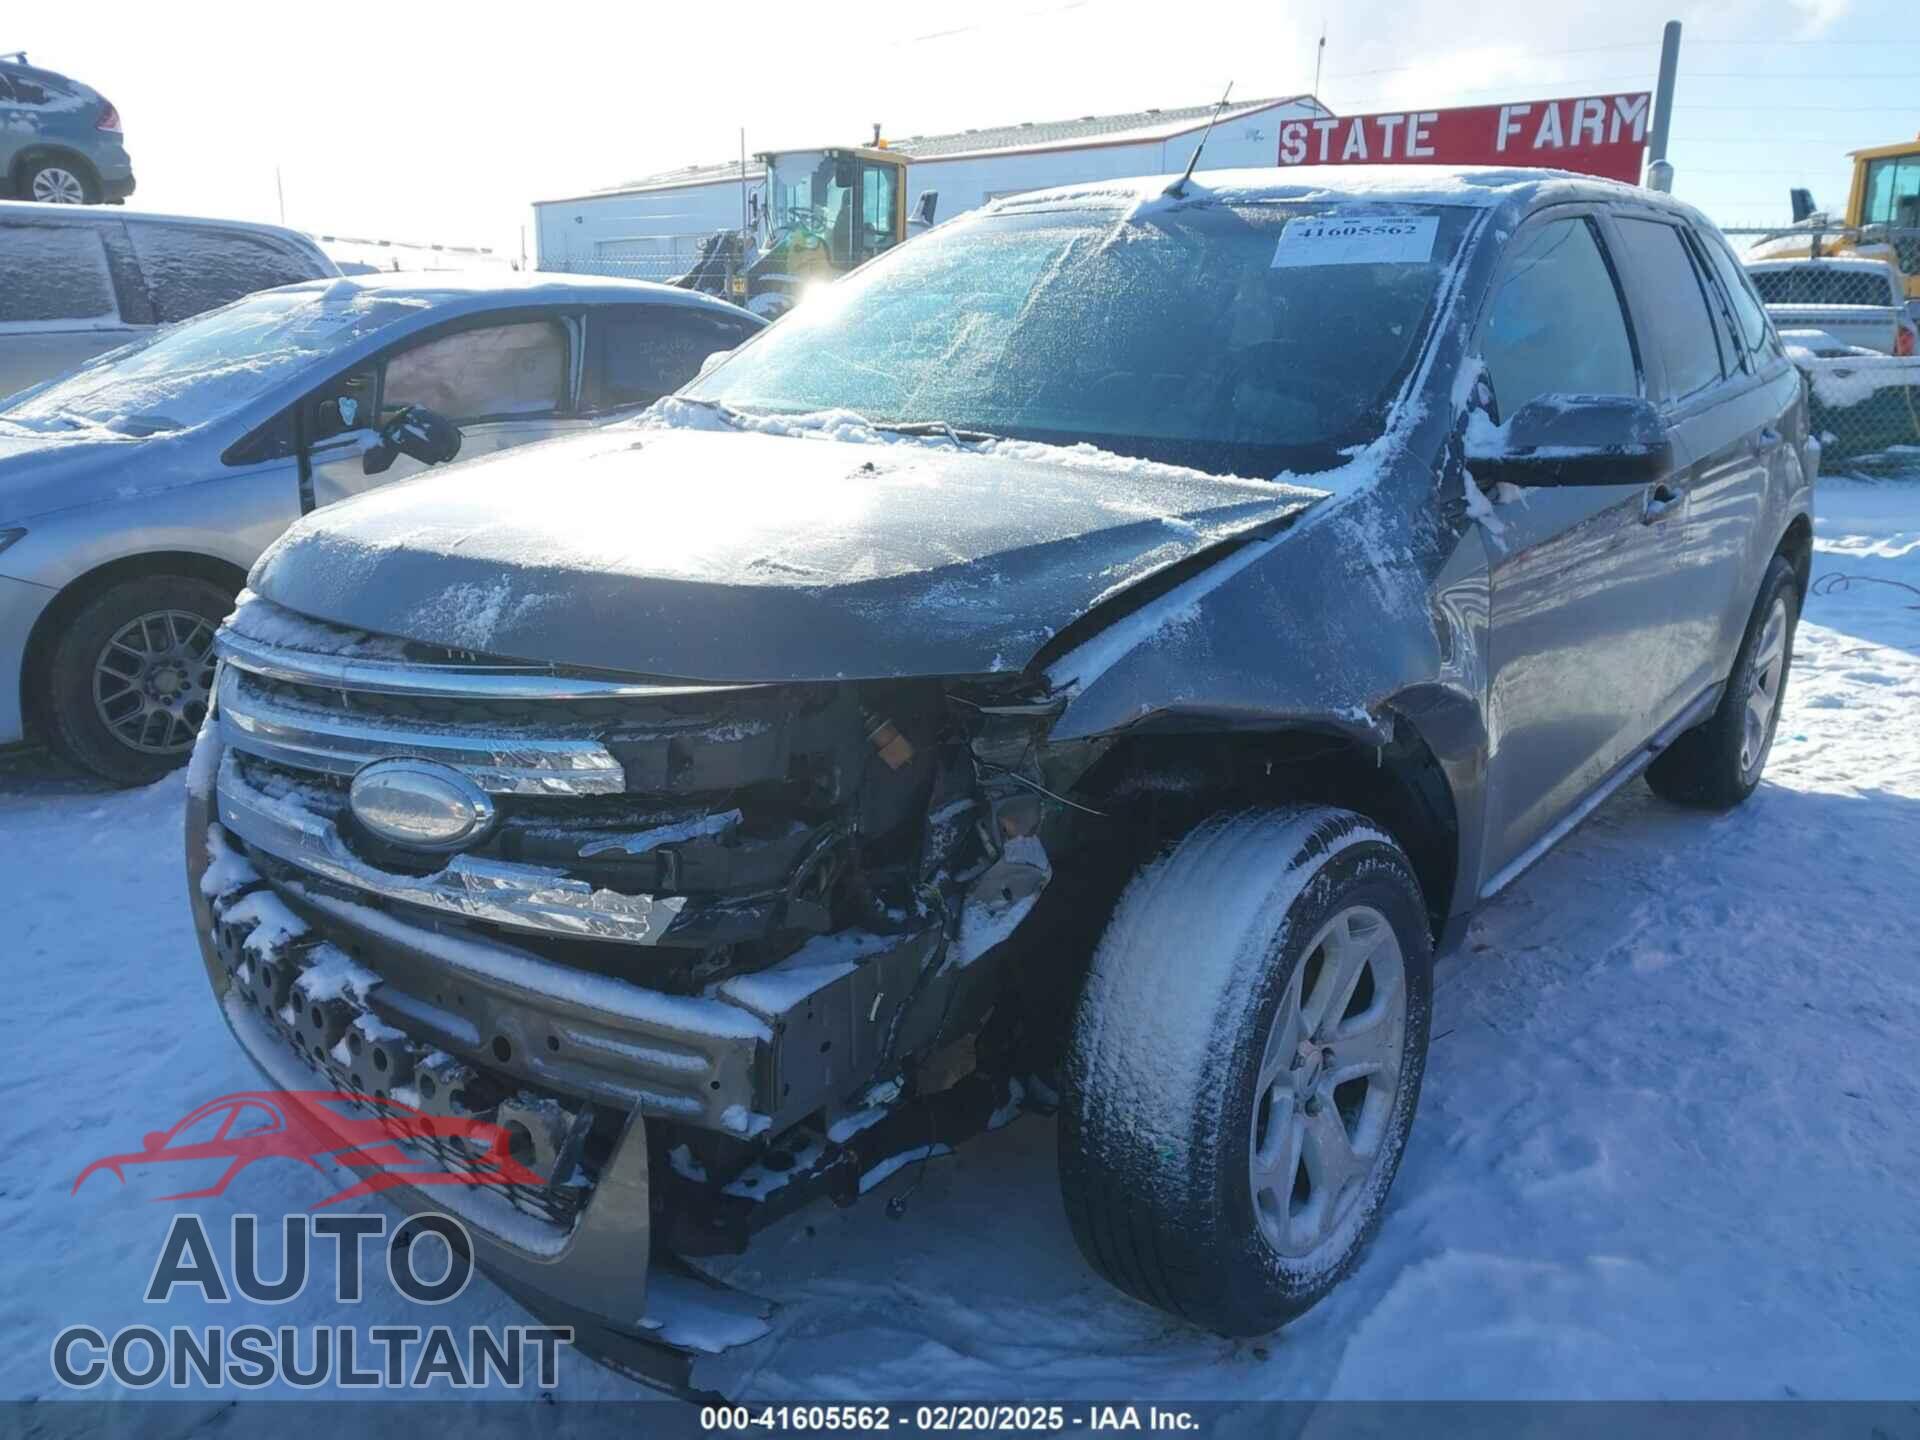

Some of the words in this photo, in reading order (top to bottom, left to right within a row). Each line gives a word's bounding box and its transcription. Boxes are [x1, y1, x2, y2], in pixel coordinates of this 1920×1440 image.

[1280, 112, 1438, 165] STATE
[1496, 93, 1648, 152] FARM
[1298, 225, 1417, 238] 41605562
